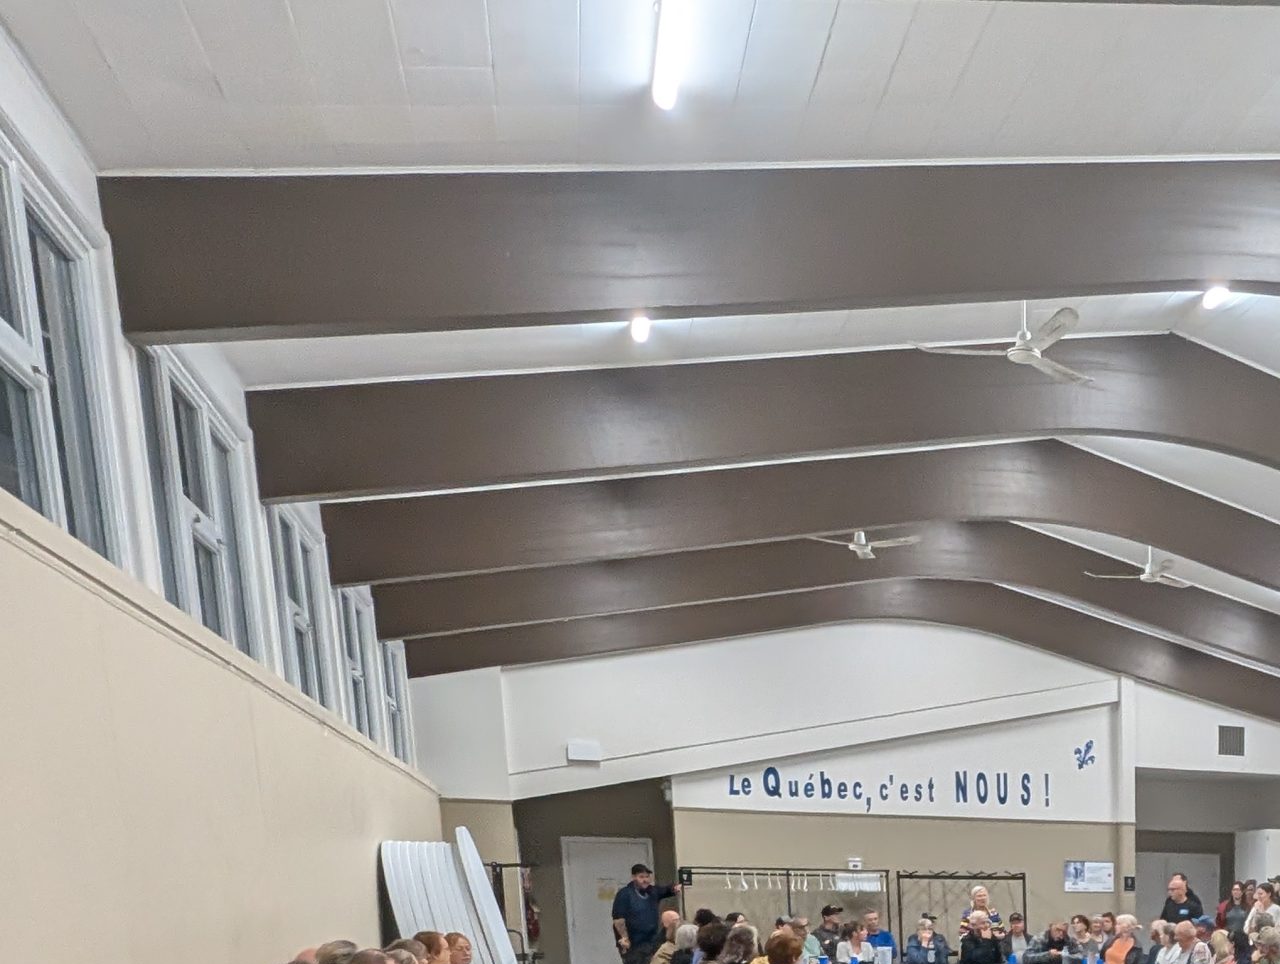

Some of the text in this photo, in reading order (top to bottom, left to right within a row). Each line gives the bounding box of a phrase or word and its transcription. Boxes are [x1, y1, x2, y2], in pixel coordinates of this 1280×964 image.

[729, 774, 751, 796] Le
[763, 766, 872, 813] Québec,
[879, 774, 935, 803] c'est
